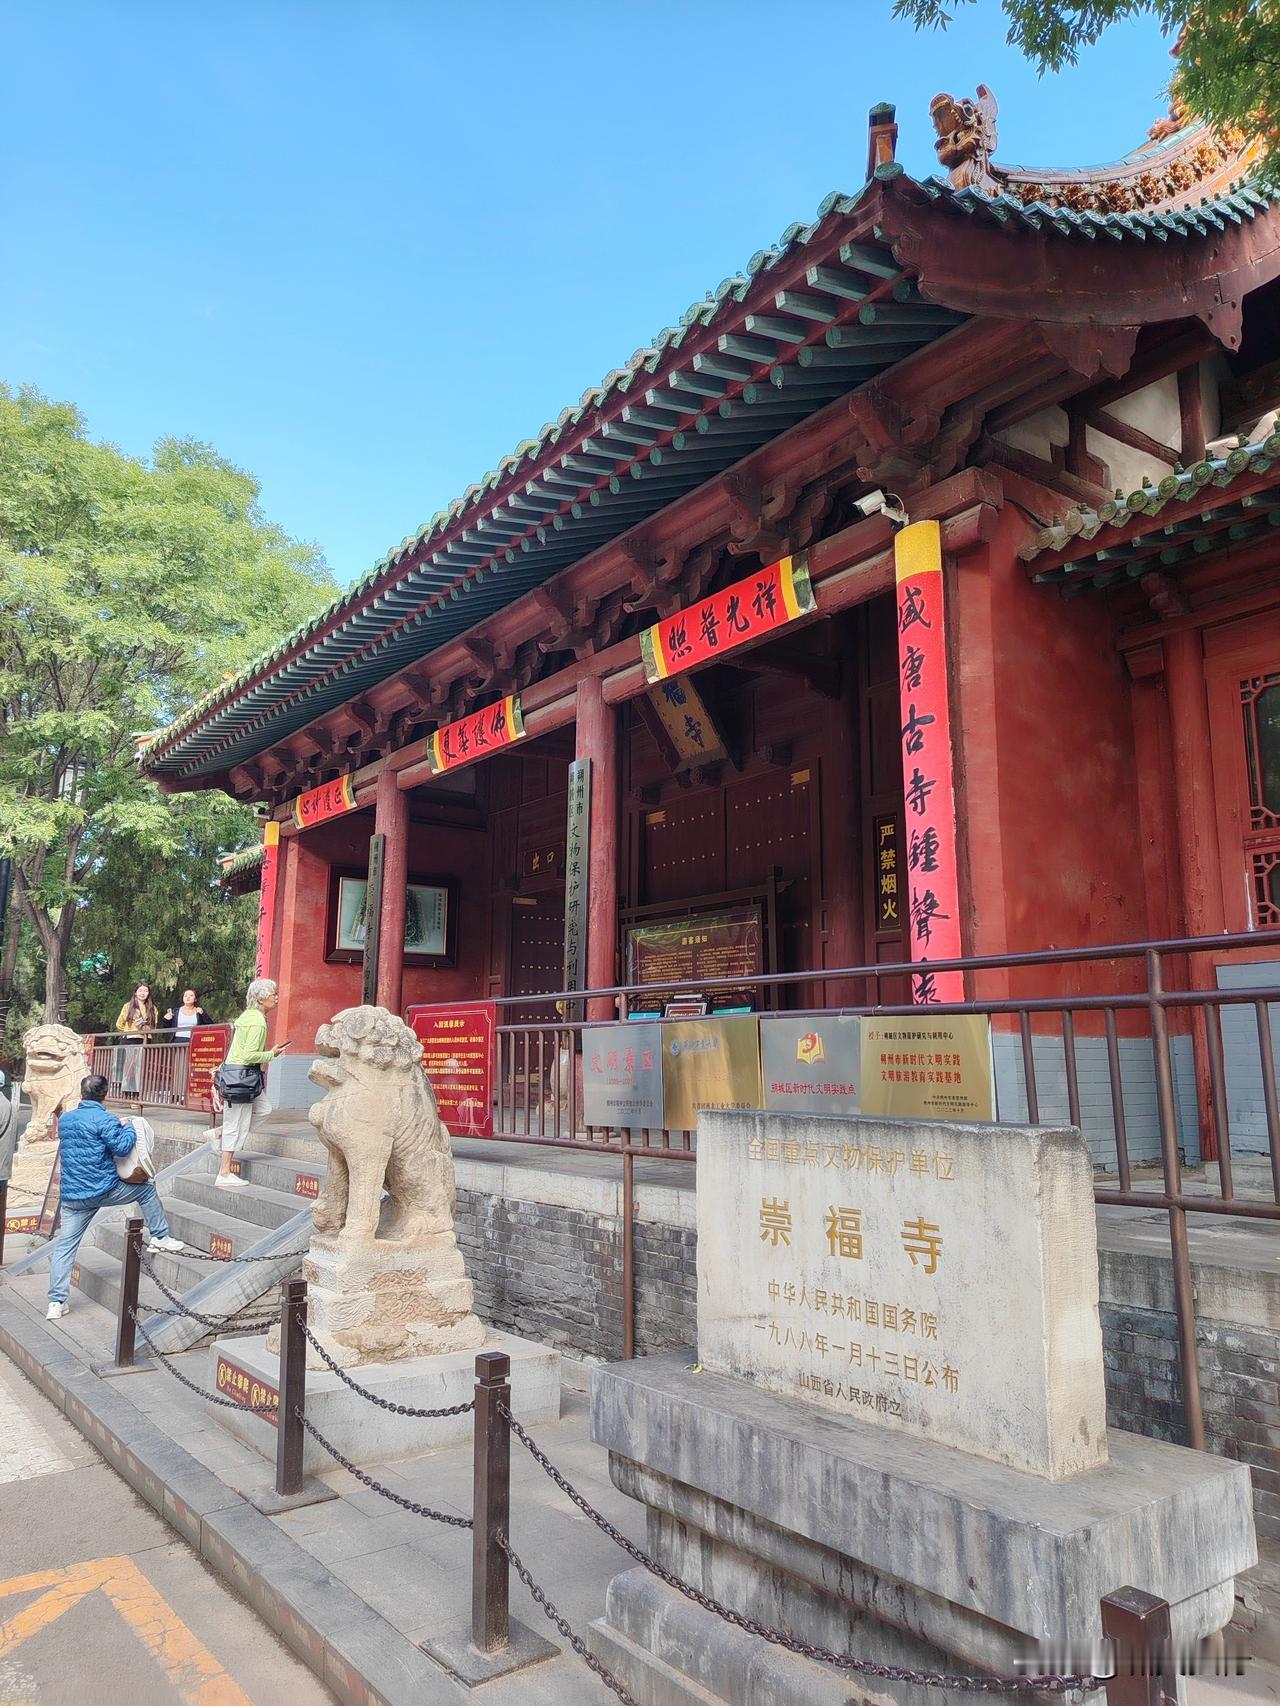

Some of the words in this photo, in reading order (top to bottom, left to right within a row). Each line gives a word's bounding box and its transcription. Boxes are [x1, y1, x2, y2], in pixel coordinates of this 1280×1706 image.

[880, 824, 897, 920] 严禁烟火
[880, 1053, 961, 1067] 朔州市新时代文明实践
[880, 1070, 962, 1084] 文明旅游教育实践基地
[749, 1136, 955, 1181] 全国重点文物保护单位
[759, 1196, 944, 1275] 崇福寺
[767, 1278, 938, 1341] 中华人民共和国国务院
[754, 1319, 960, 1394] 一九八八年一月十三日公布
[799, 1372, 903, 1417] 山西省人民政府立
